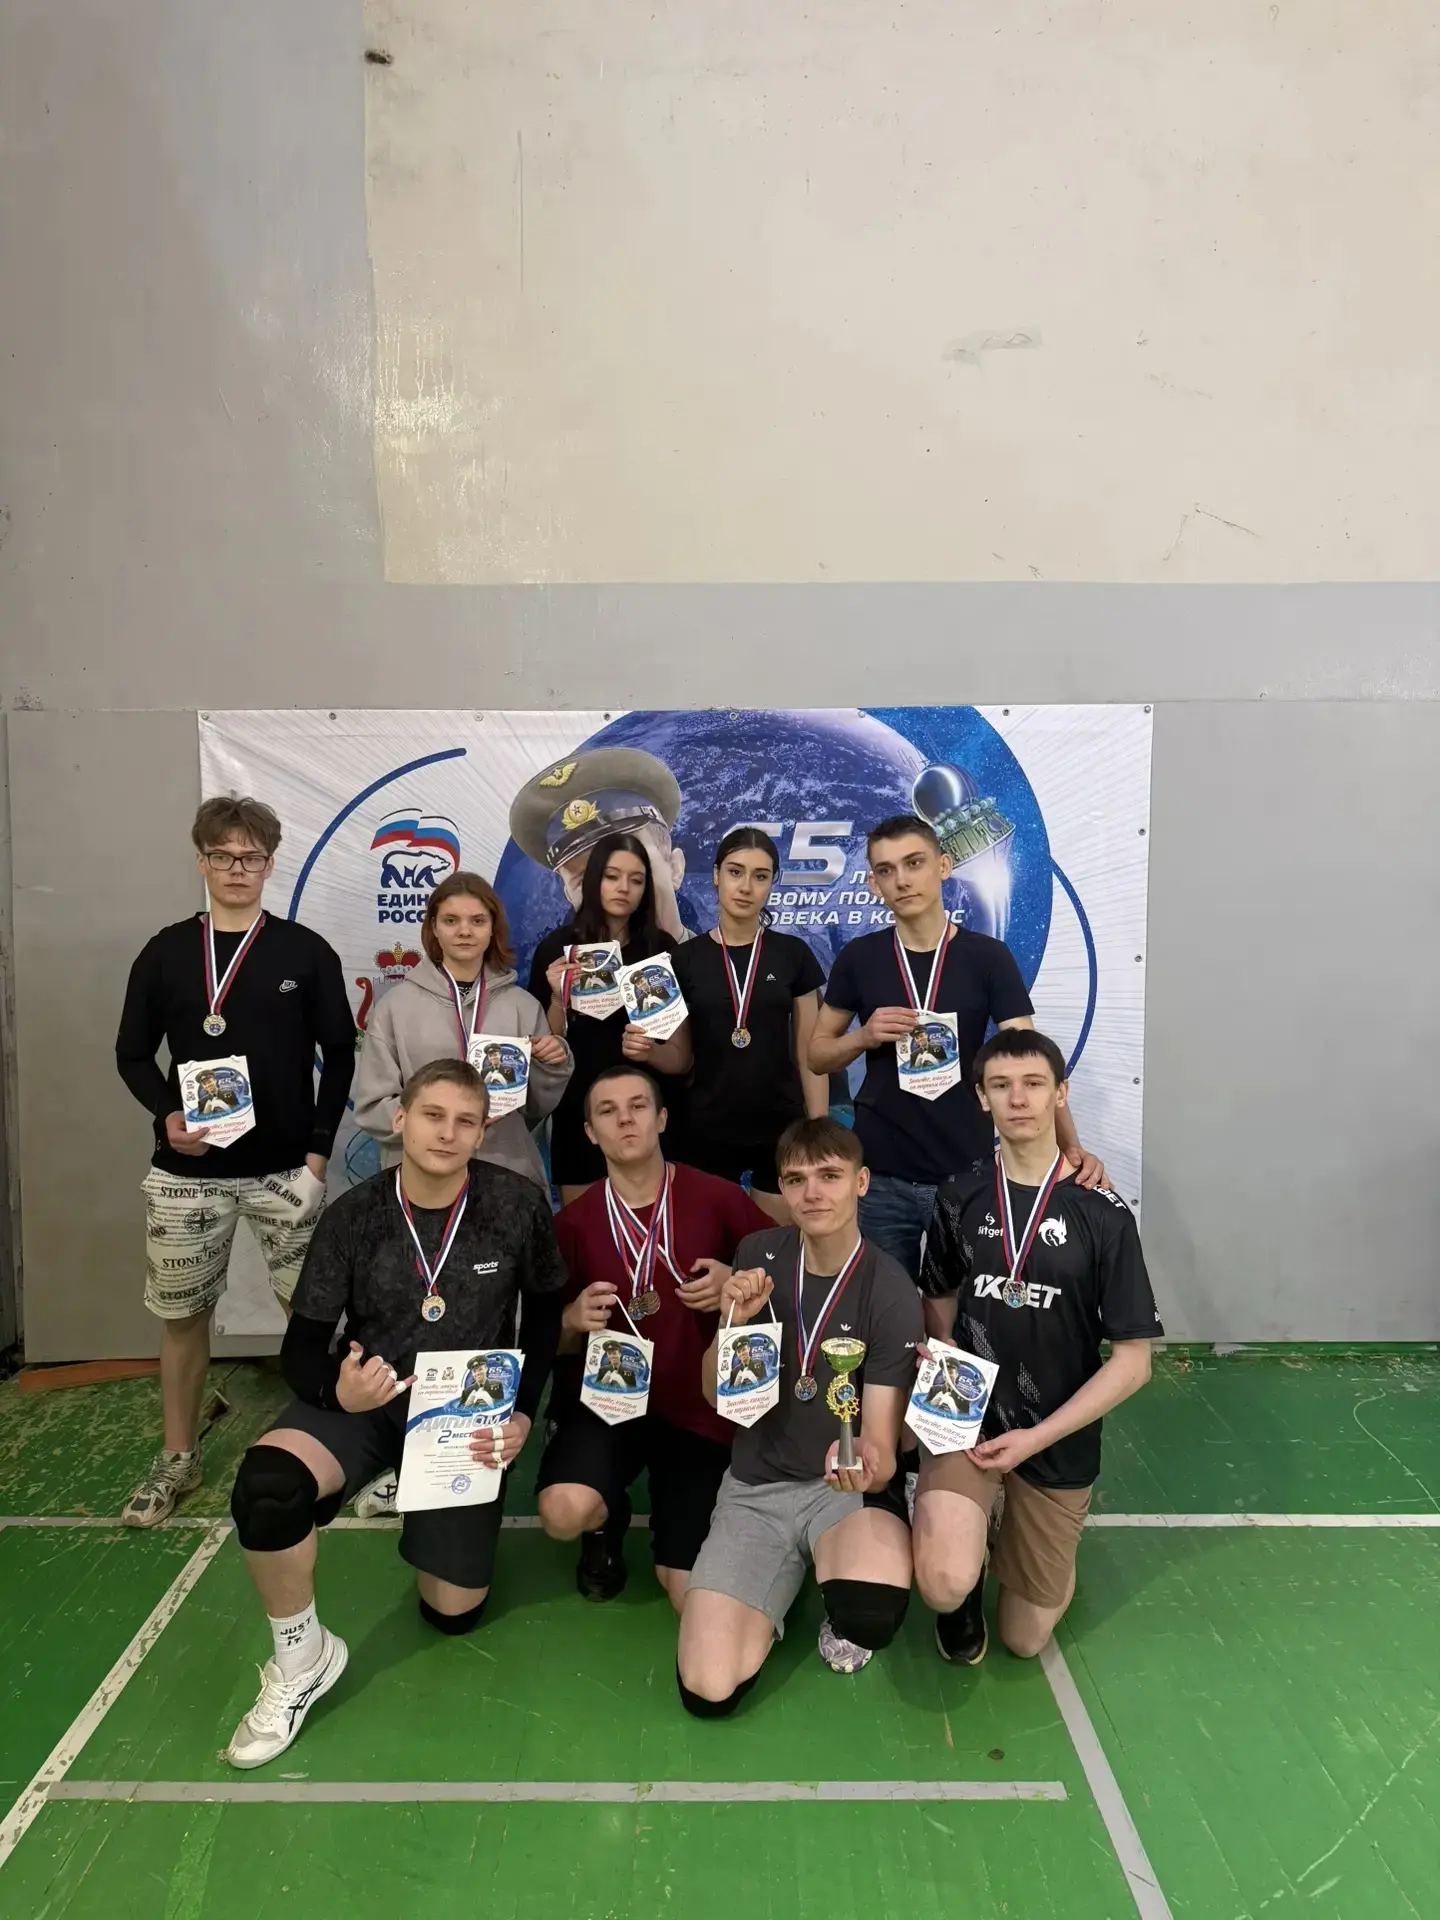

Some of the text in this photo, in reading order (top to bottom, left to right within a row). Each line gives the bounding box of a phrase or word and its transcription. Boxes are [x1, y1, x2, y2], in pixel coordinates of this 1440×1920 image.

[377, 893, 429, 908] ЕДИН
[767, 891, 832, 906] ВОМУ
[378, 909, 427, 923] РОСС
[847, 911, 860, 924] В
[160, 1186, 199, 1199] STONE
[265, 1179, 304, 1208] ISLAND
[1092, 1184, 1127, 1210] BET
[162, 1255, 203, 1269] STONE
[472, 1261, 499, 1275] sports
[160, 1286, 201, 1300] STONE
[974, 1274, 1061, 1309] 1XET
[437, 1429, 452, 1444] 2
[280, 1615, 312, 1635] JUST
